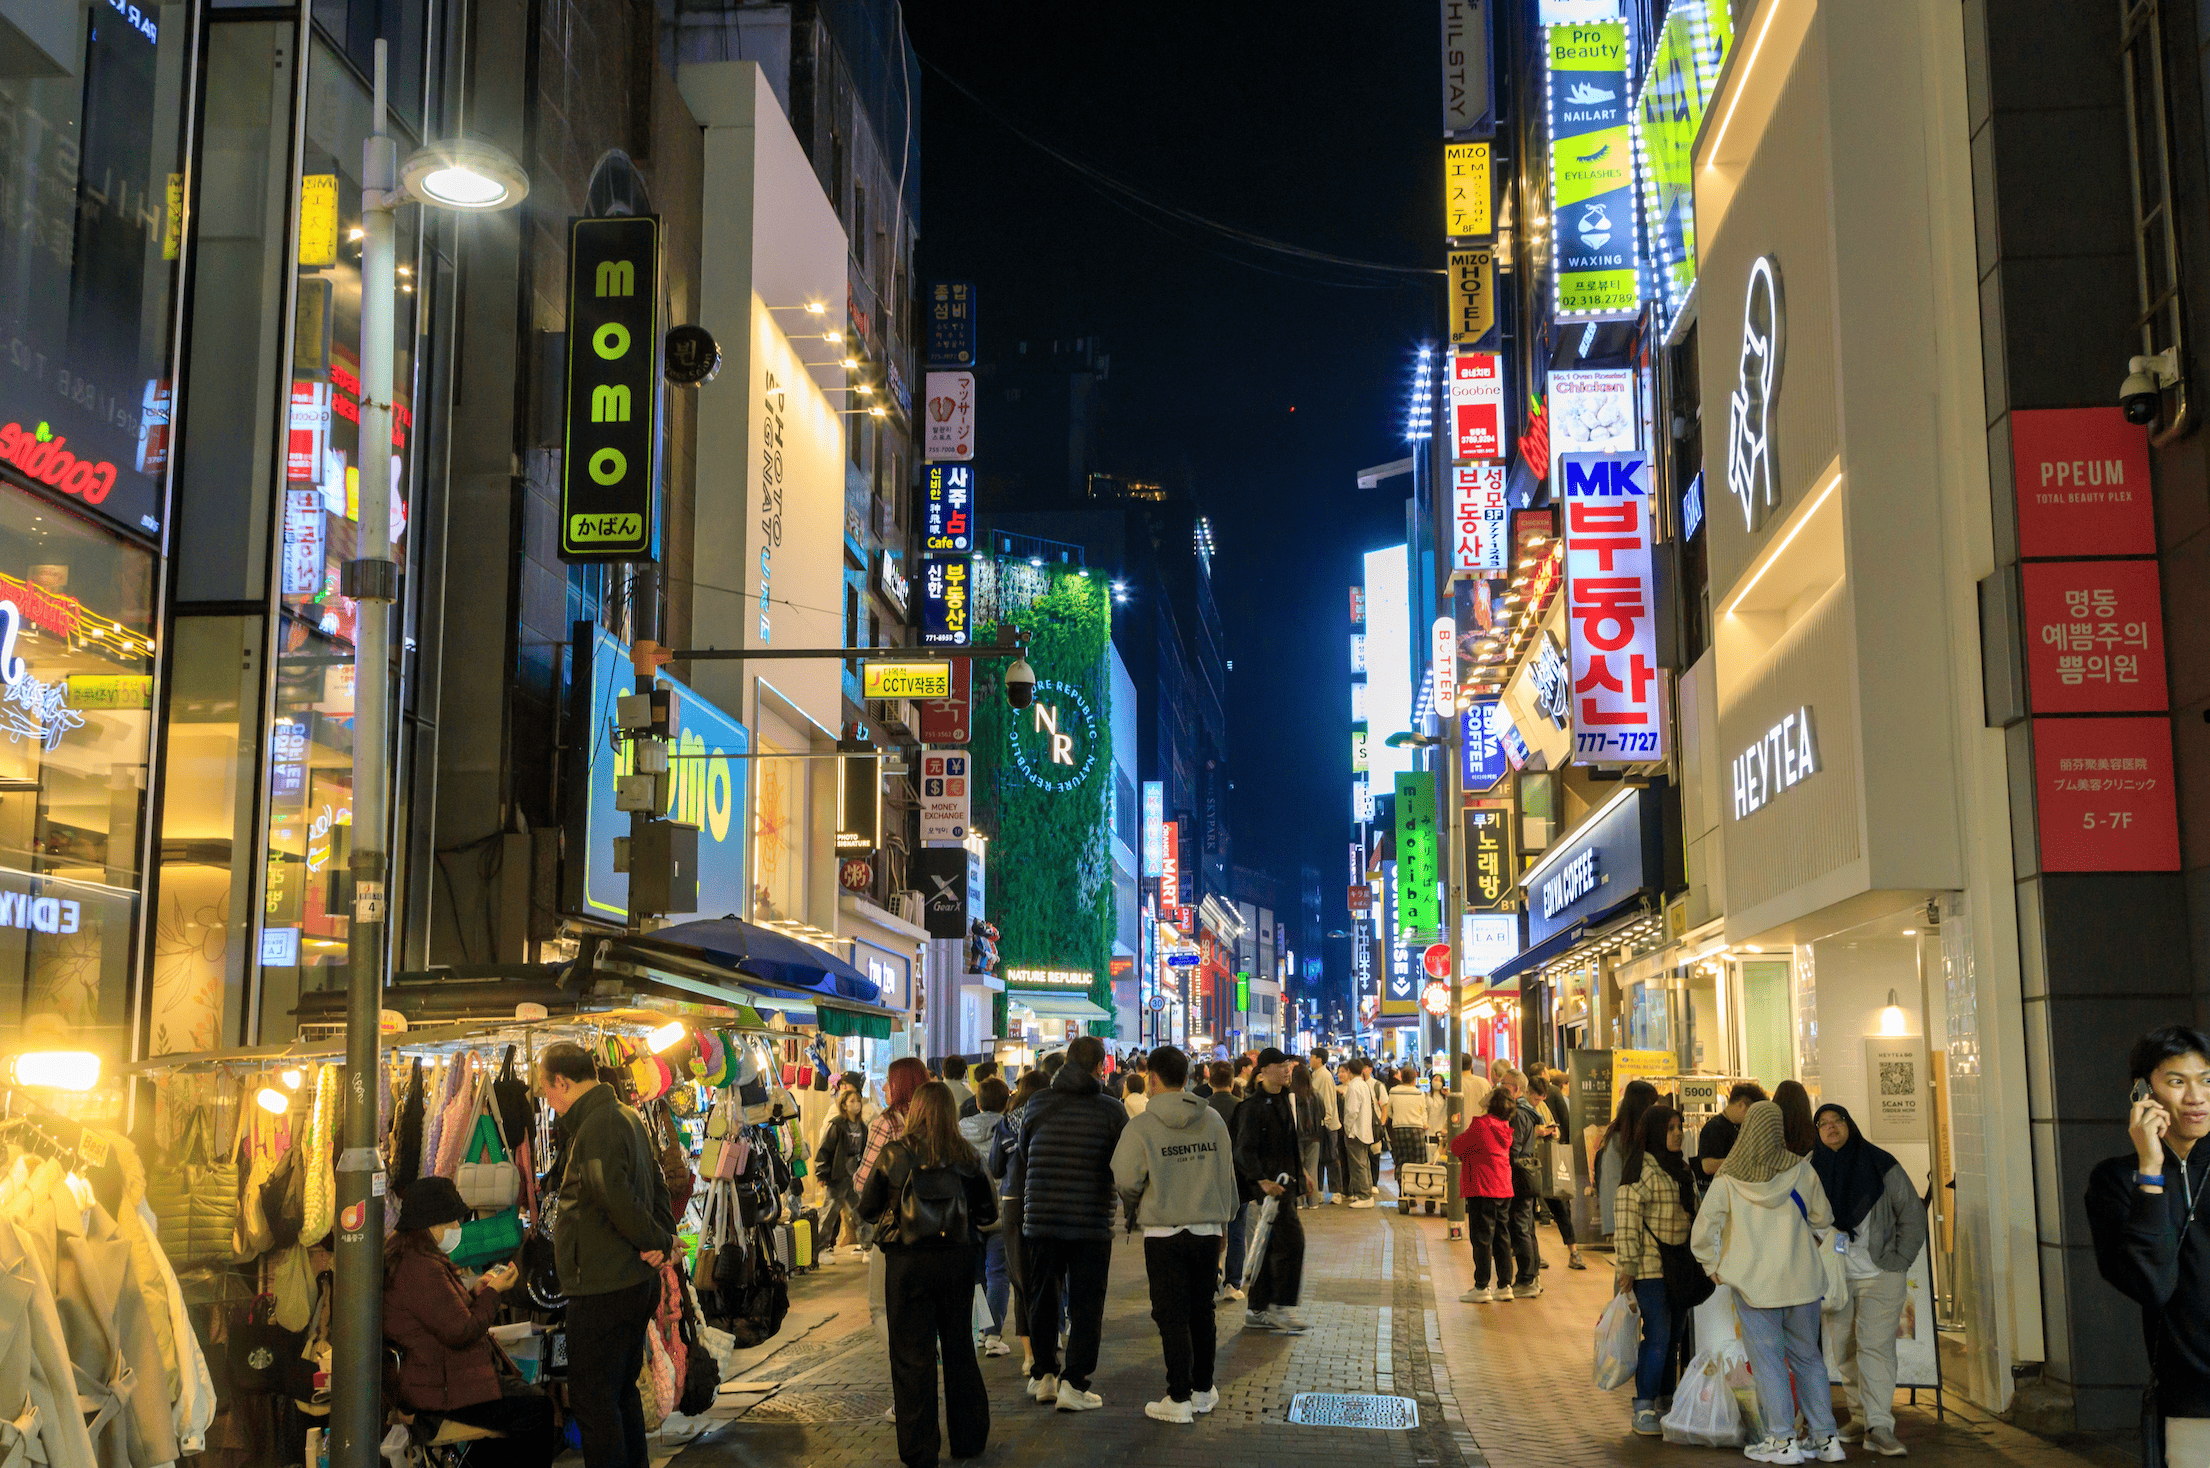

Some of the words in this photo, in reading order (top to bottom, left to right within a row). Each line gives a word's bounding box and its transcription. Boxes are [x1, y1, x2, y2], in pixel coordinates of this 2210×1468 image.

[1573, 30, 1600, 44] Pro
[1448, 3, 1465, 117] HILSTAY
[1556, 44, 1619, 60] Beauty
[1564, 110, 1616, 122] NAILART
[1448, 148, 1486, 159] MIZO
[1564, 169, 1622, 181] EYELASHES
[1452, 165, 1466, 225] エステ
[1452, 254, 1489, 265] MIZO
[1568, 255, 1623, 268] WAXING
[934, 284, 968, 300] 종합
[1574, 279, 1620, 291] 프로뷰티
[1461, 266, 1481, 332] HOTEL
[1562, 293, 1633, 306] 02.318.2789
[588, 259, 635, 486] momo
[1452, 385, 1501, 397] Goobne
[1556, 381, 1624, 394] Chicken
[773, 382, 785, 546] PHOTO
[2040, 459, 2124, 487] PPEUM
[1566, 460, 1645, 496] MK
[1484, 469, 1503, 508] 성모
[2036, 493, 2065, 504] TOTAL
[2068, 492, 2105, 504] BEAUTY
[2108, 491, 2132, 502] PLEX
[759, 370, 774, 645] SIGNATURE
[1486, 510, 1502, 520] 3F
[577, 517, 637, 537] かばん
[1457, 469, 1483, 567] 부동산
[927, 536, 954, 549] Cafe
[927, 565, 943, 598] 신한
[944, 564, 966, 631] 부동산
[2065, 589, 2118, 618] 명동
[1569, 500, 1655, 726] 부동산
[2042, 622, 2148, 651] 예쁨주의
[2056, 655, 2138, 685] 쁨의원
[883, 677, 946, 694] CCTV작동중
[1056, 681, 1097, 740] REPUBLIC
[1468, 706, 1484, 773] COFFEE
[1577, 732, 1657, 753] 777-7727
[613, 687, 732, 843] mo
[1733, 705, 1814, 820] HEYTEA
[1497, 784, 1510, 795] 1F
[924, 812, 964, 820] EXCHANGE
[931, 803, 958, 812] MONEY
[1473, 813, 1500, 829] 루키
[1477, 831, 1500, 899] 노래방
[1163, 858, 1176, 908] MART
[1543, 873, 1564, 919] EDIYA
[1563, 847, 1594, 906] COFFEE
[933, 901, 962, 912] GearX
[1501, 900, 1516, 911] B1
[1476, 932, 1505, 942] LAB
[1202, 939, 1211, 966] SPAO
[1007, 970, 1046, 982] NATURE
[1048, 971, 1093, 984] REPUBLIC
[1684, 1087, 1713, 1097] 5900
[1161, 1142, 1217, 1157] ESSENTIALS
